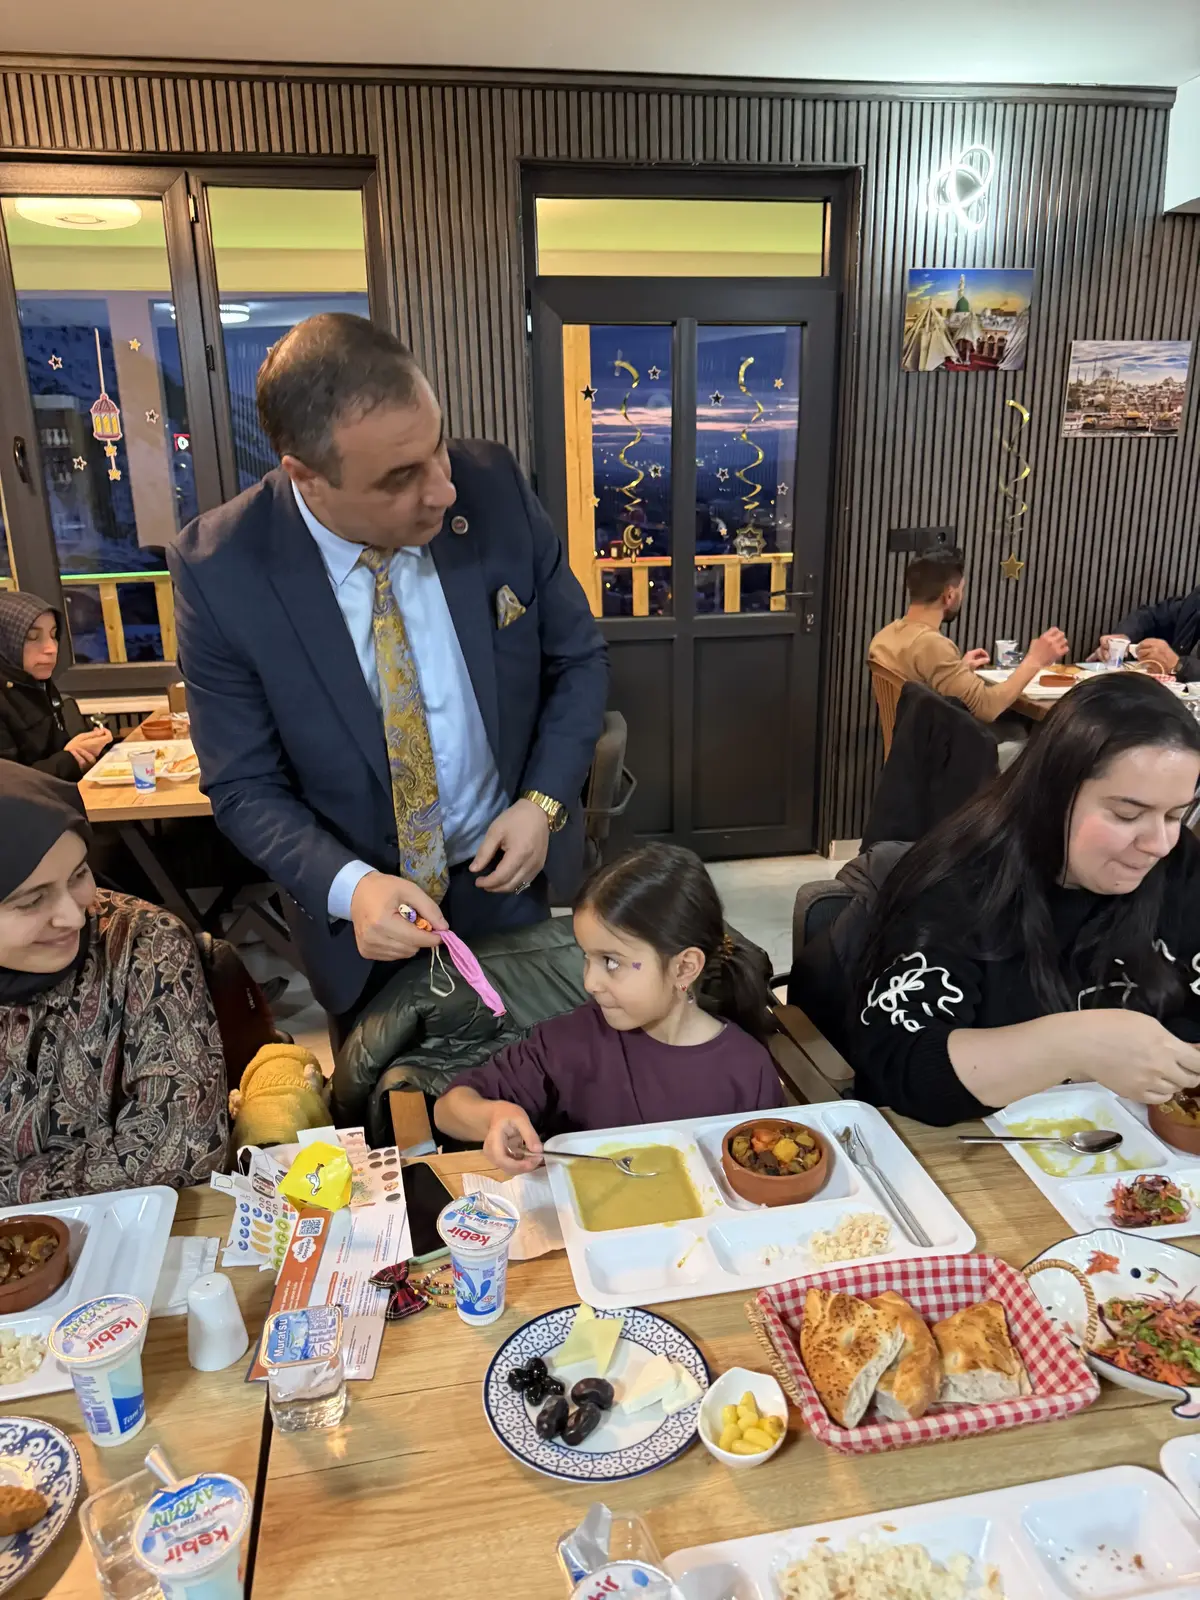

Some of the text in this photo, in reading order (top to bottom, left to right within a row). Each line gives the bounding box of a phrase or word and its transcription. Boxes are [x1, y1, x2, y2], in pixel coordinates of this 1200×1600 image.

[447, 1226, 491, 1246] kebir
[87, 1317, 138, 1352] kebir
[274, 1318, 288, 1357] Muratsu
[164, 1526, 230, 1564] kebir
